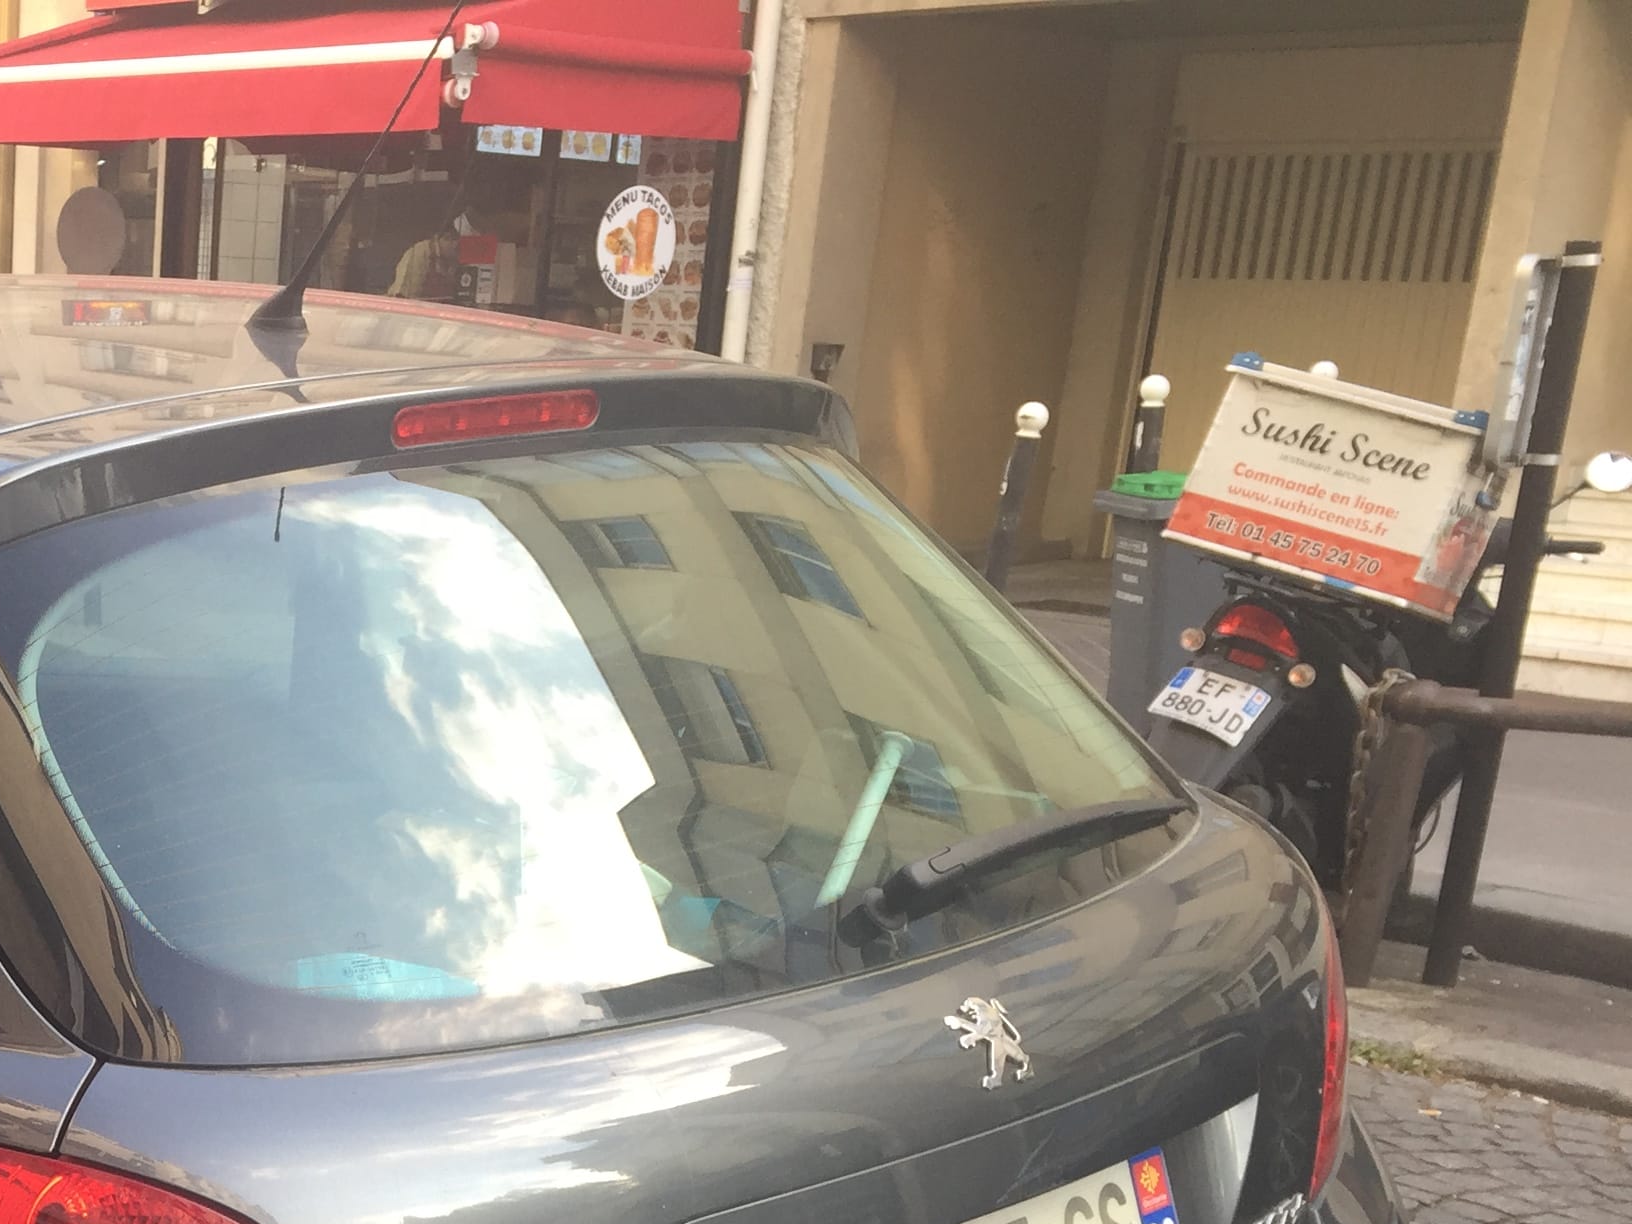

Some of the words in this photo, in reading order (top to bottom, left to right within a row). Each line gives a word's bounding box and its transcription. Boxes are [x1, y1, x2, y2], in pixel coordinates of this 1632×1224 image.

[606, 189, 638, 222] MENU
[640, 190, 672, 225] TACOS
[601, 264, 629, 296] KEBAB
[631, 265, 667, 297] MAISON
[1242, 407, 1335, 454] Sushi
[1340, 433, 1431, 482] Scene
[1233, 461, 1328, 500] Commande
[1330, 491, 1351, 506] en
[1241, 523, 1265, 542] 01
[1269, 530, 1293, 549] 45
[1298, 539, 1321, 558] 75
[1325, 548, 1350, 567] 24
[1354, 555, 1381, 576] 70
[1198, 678, 1237, 698] EF
[1162, 692, 1244, 734] 880-JD
